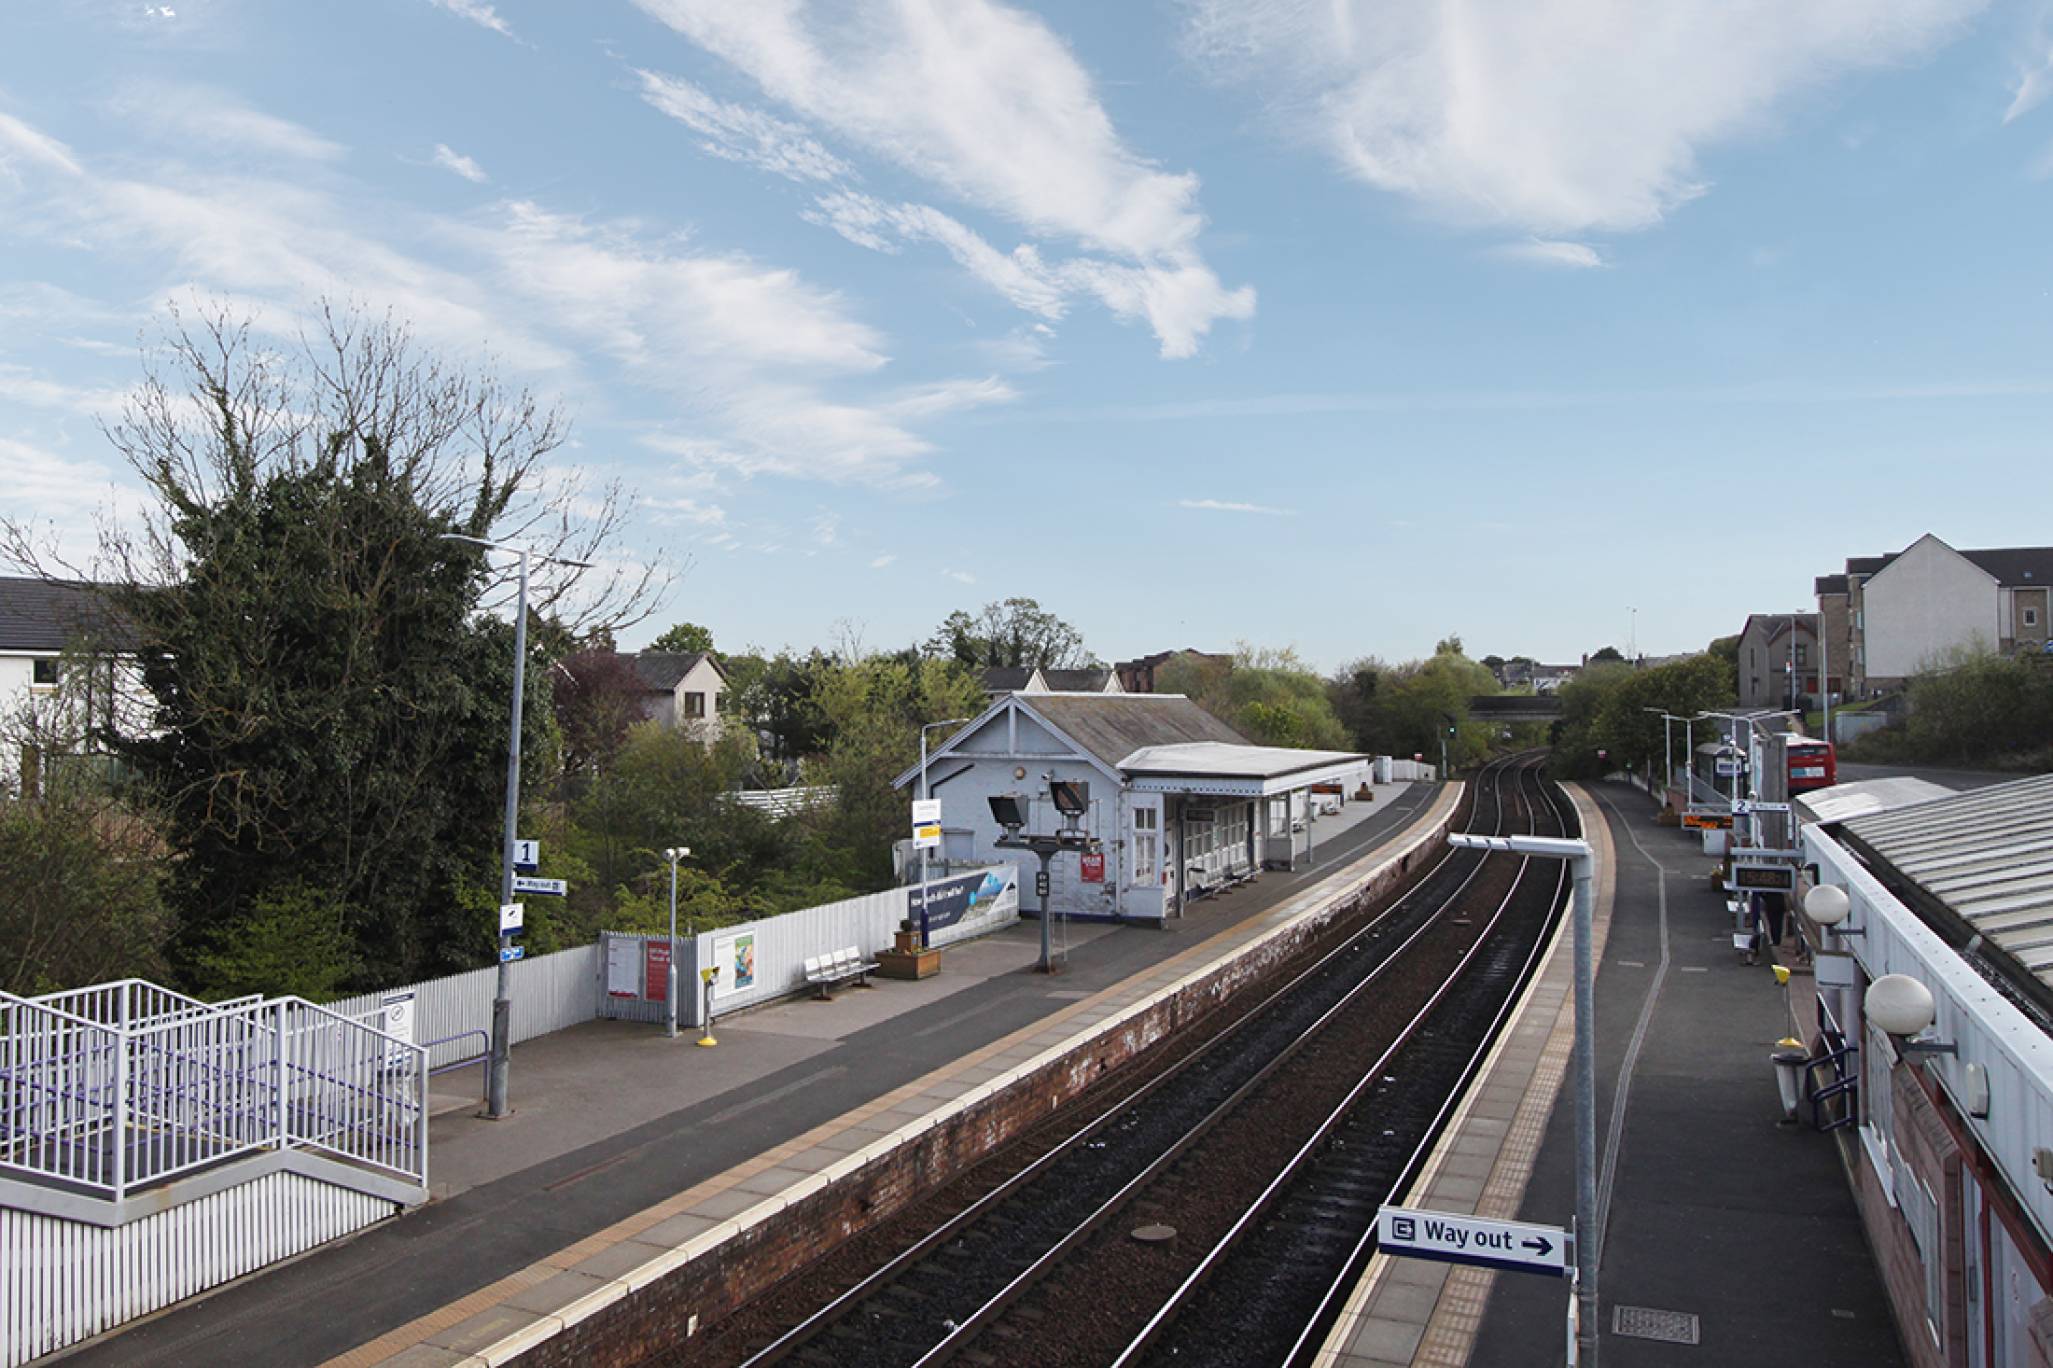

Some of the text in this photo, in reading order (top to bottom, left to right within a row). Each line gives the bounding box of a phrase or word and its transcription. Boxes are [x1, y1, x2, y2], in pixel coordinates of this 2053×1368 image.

[1737, 800, 1746, 812] 2
[521, 843, 531, 862] 1
[1424, 1220, 1513, 1249] Way out
